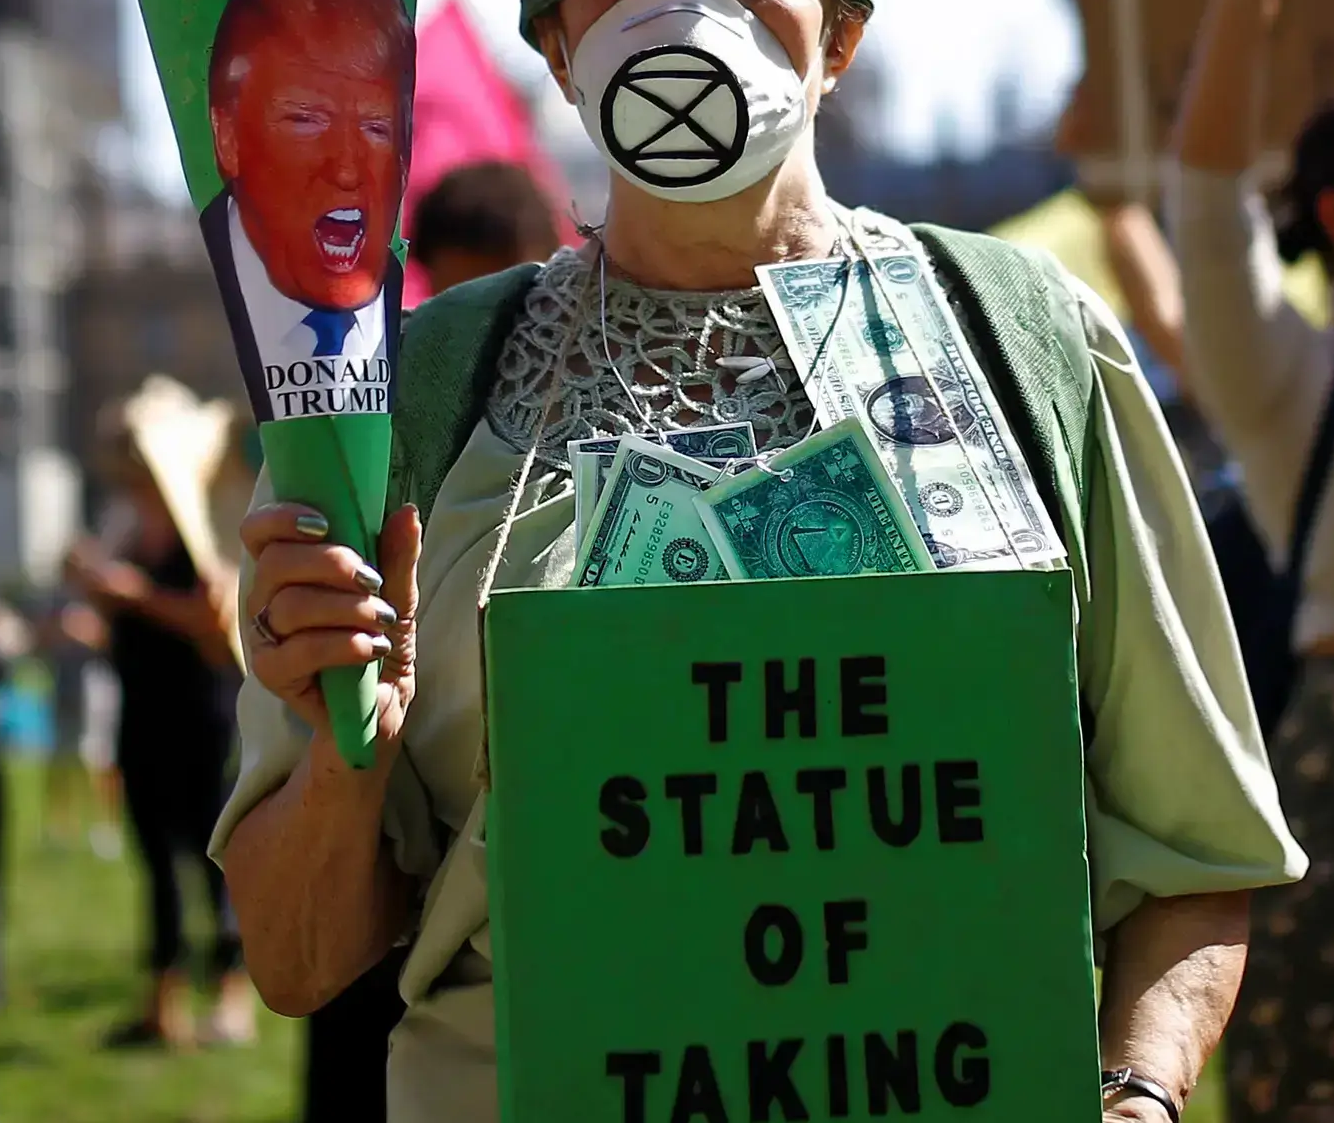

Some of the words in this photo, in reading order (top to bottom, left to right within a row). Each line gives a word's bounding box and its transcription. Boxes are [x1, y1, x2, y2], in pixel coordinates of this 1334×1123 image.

[265, 359, 390, 391] DONALD
[277, 387, 387, 417] TRUMP
[982, 420, 1007, 459] ONE
[675, 551, 695, 570] E
[691, 655, 889, 743] THE
[598, 760, 984, 859] STATUE
[743, 898, 869, 987] OF
[605, 1021, 992, 1123] TAKING
